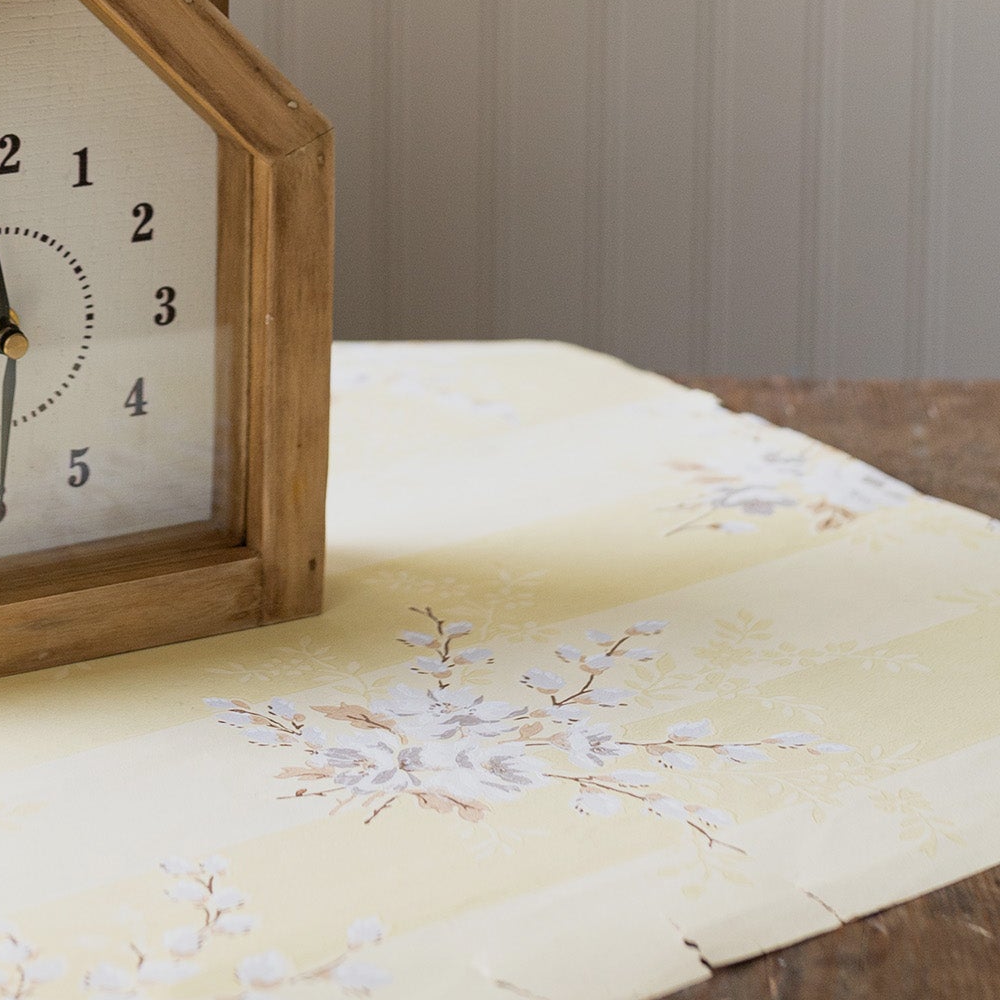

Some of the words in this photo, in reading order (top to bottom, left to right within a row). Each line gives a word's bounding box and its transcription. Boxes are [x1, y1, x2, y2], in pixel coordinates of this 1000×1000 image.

[72, 147, 94, 188] 1
[130, 201, 155, 244] 2
[153, 285, 177, 327] 3
[123, 376, 149, 418] 4
[67, 446, 91, 489] 5
